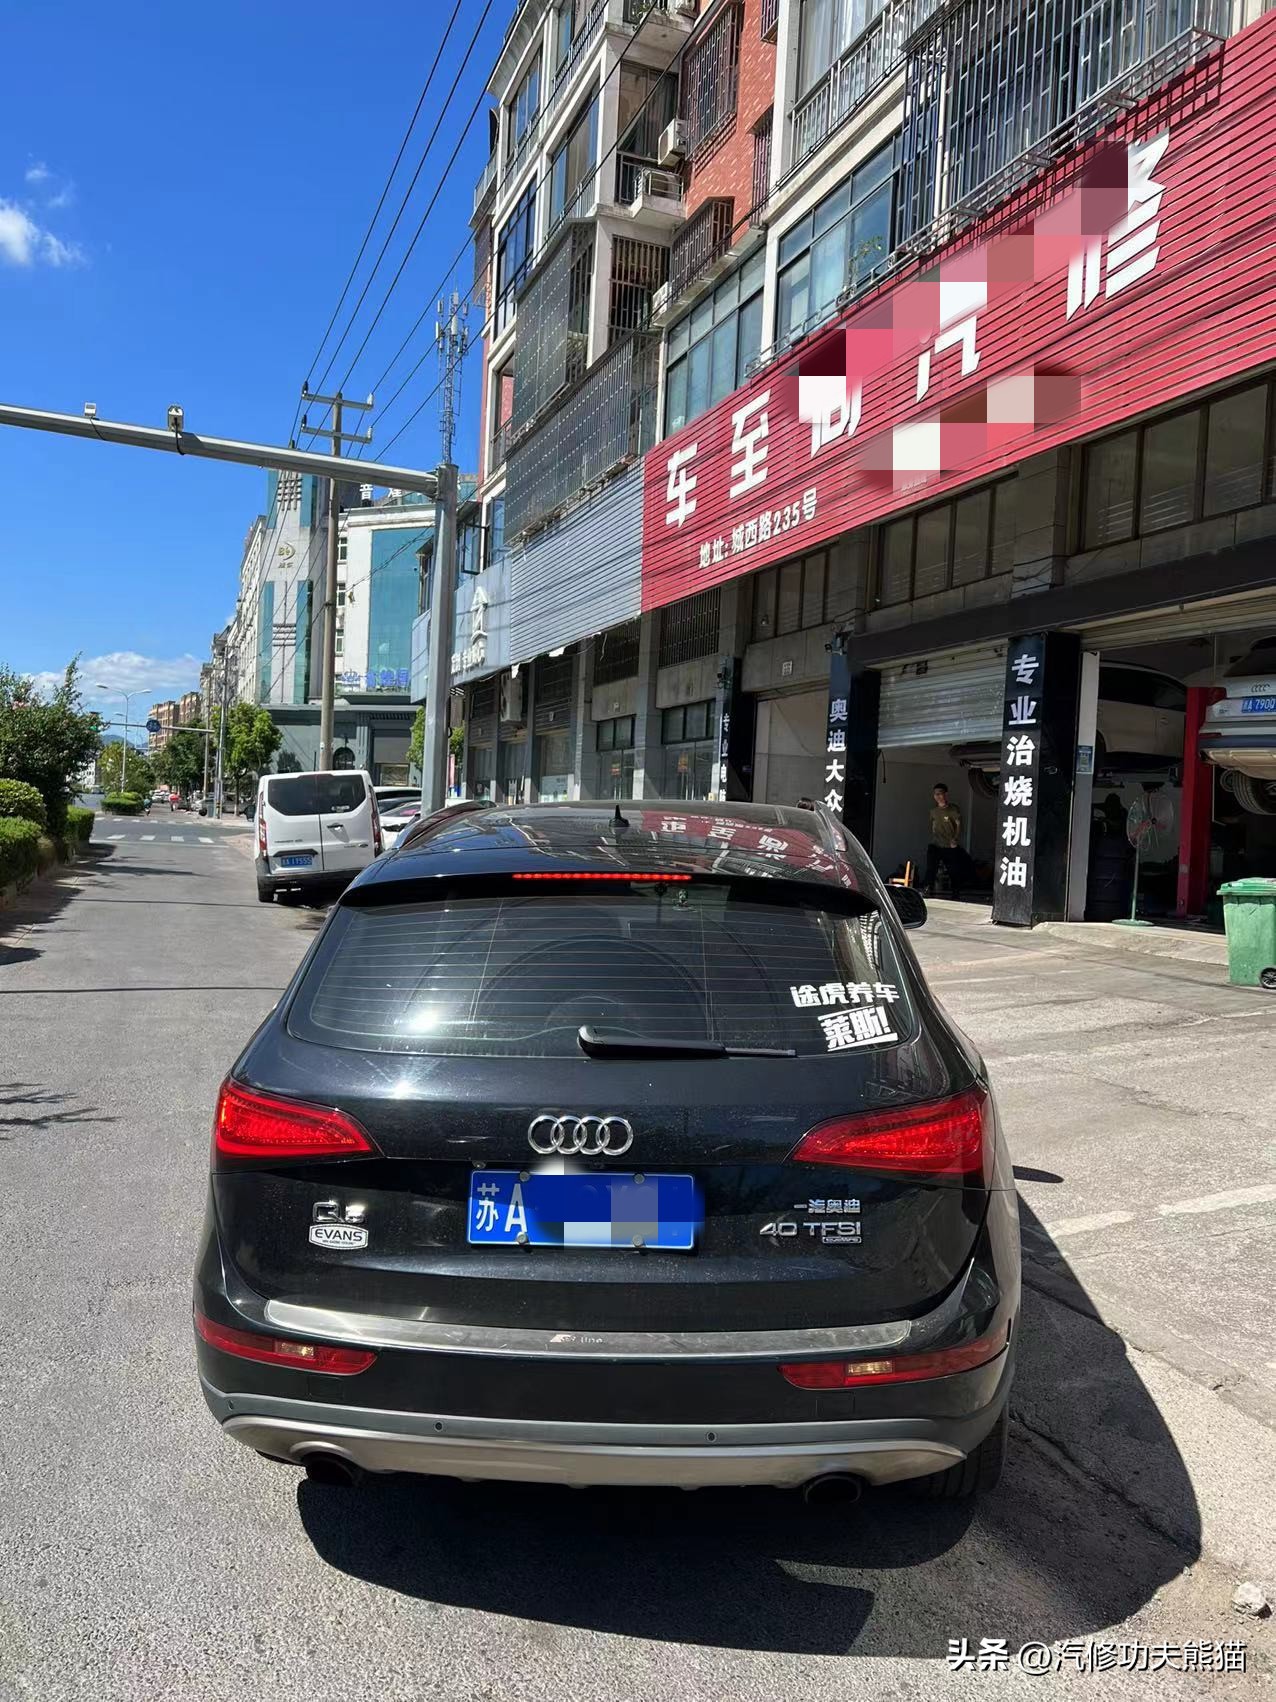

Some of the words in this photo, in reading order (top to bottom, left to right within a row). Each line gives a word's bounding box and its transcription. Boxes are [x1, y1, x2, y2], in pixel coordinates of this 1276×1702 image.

[823, 699, 848, 813] 奥迪大众
[999, 653, 1040, 888] 专业治烧机油
[790, 982, 900, 1008] 途虎养车
[793, 1199, 861, 1214] 一汽奥迪
[315, 1228, 362, 1241] EVANS
[760, 1222, 798, 1236] 40
[803, 1222, 861, 1236] TFSI
